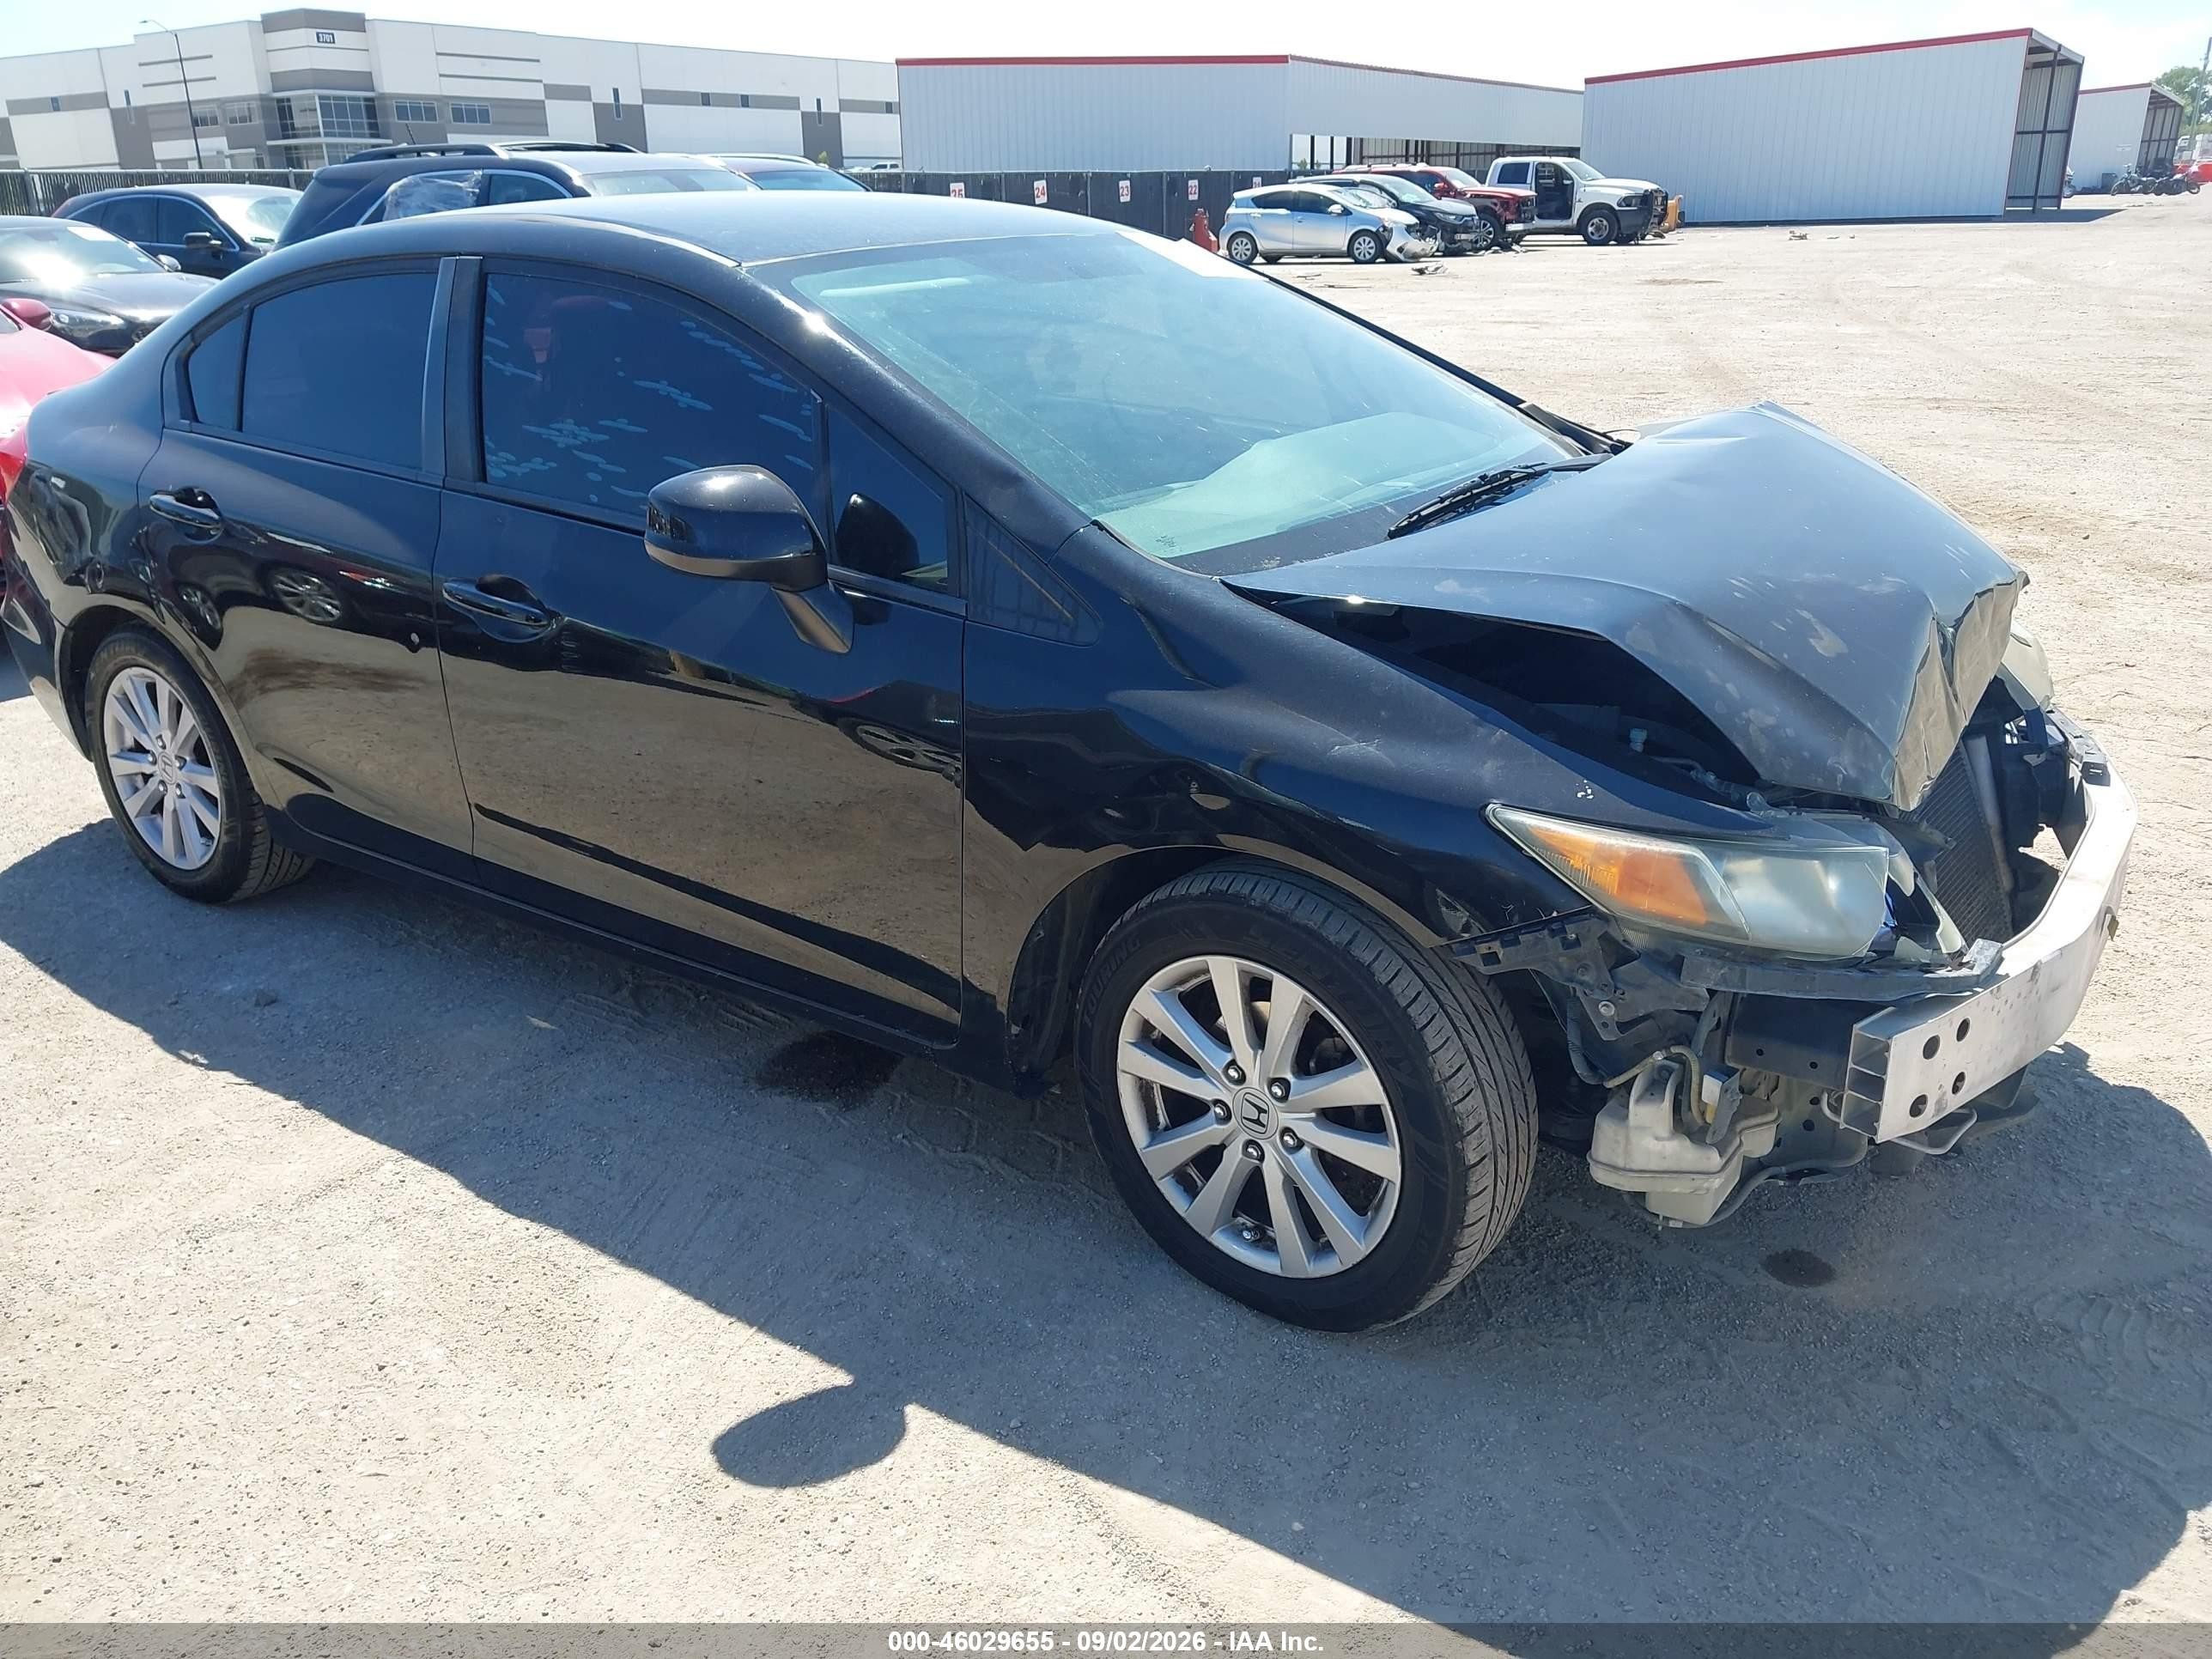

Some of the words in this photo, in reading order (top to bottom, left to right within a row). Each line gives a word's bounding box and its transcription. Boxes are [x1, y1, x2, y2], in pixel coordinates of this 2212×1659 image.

[318, 33, 334, 43] 3701
[1035, 185, 1046, 198] 24
[1120, 185, 1129, 197] 23
[1188, 185, 1198, 196] 22
